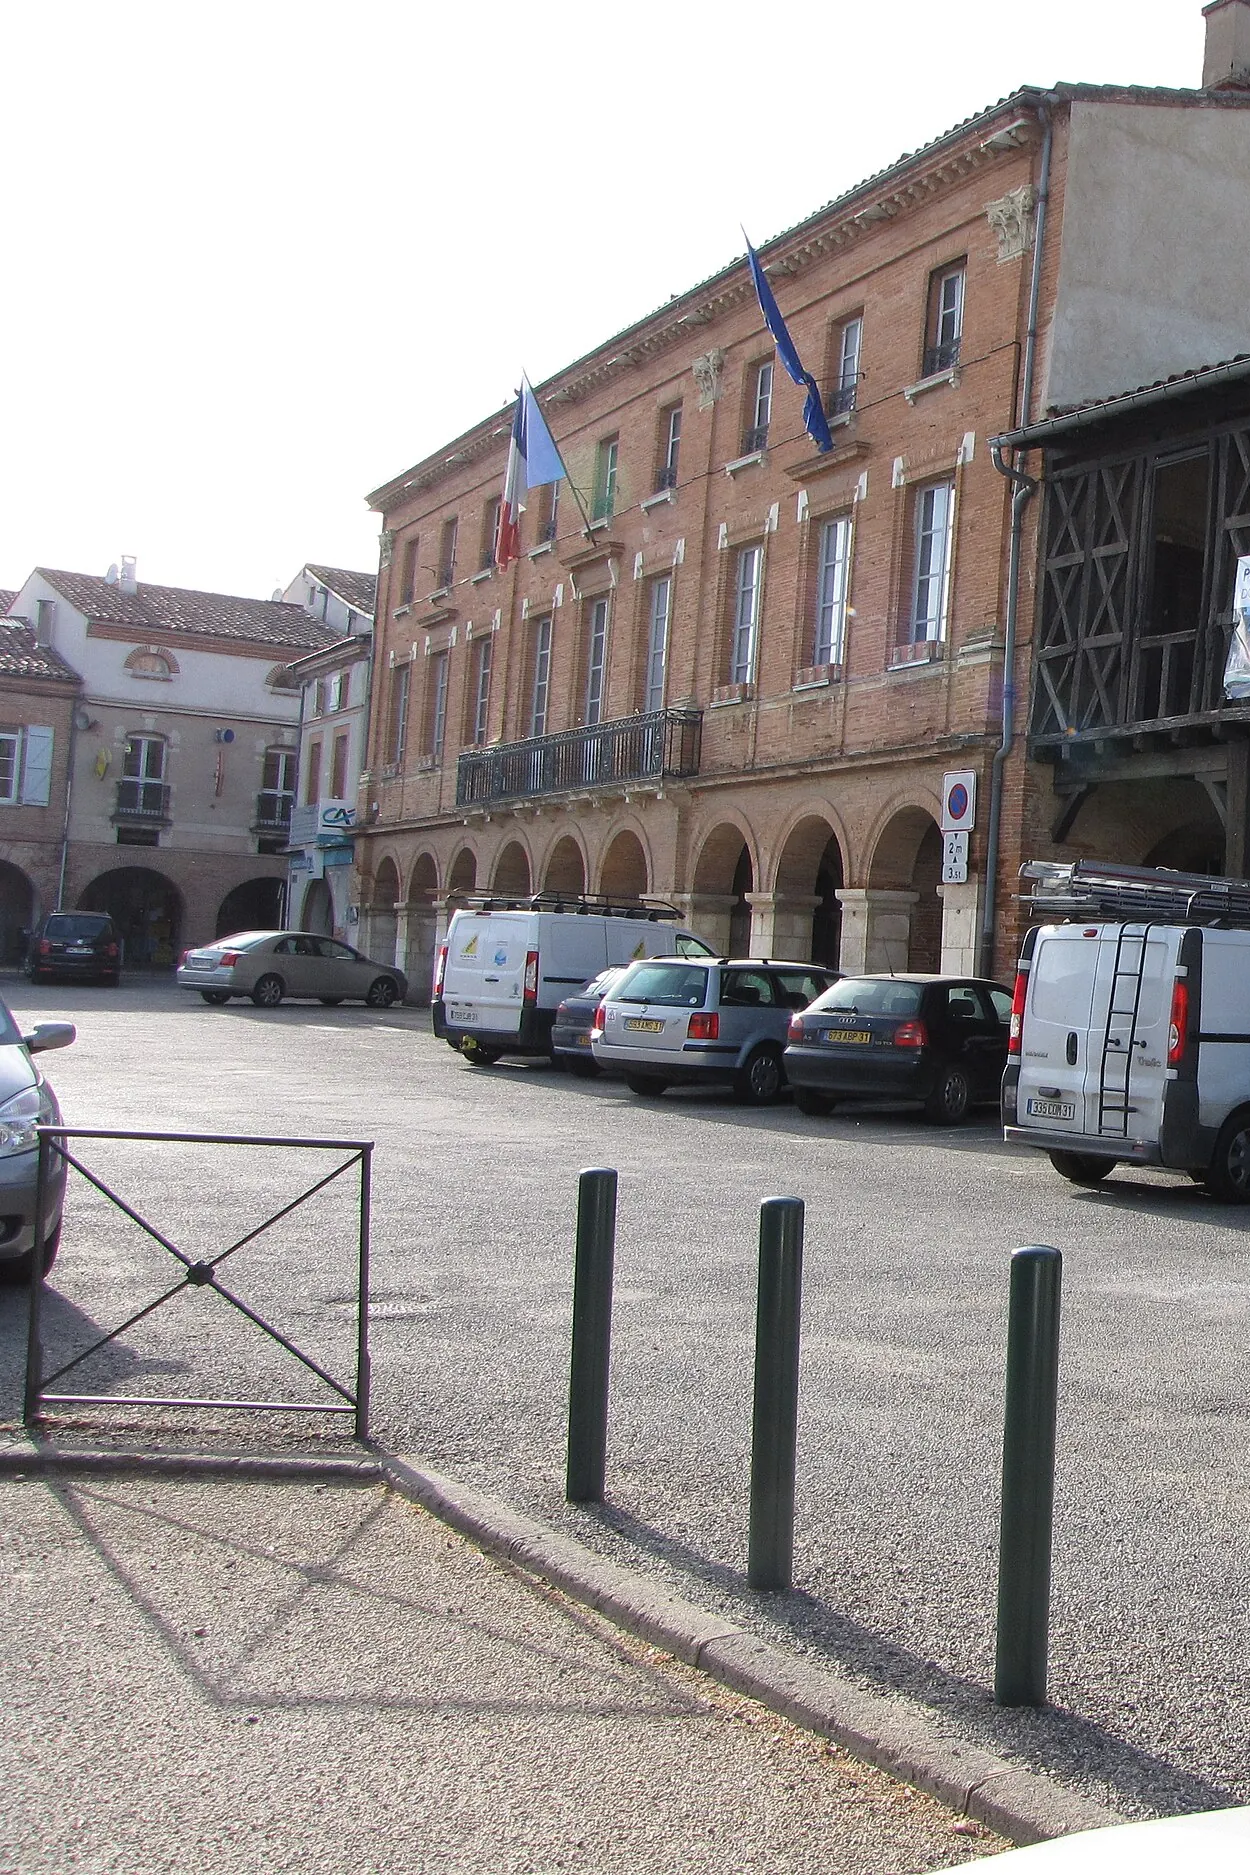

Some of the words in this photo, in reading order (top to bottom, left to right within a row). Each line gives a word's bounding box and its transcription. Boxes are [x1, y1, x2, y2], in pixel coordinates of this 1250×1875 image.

[949, 843, 954, 854] 2
[955, 845, 963, 853] m
[828, 1030, 842, 1040] 673
[843, 1031, 857, 1041] ABP
[859, 1032, 869, 1042] 31
[1062, 1105, 1072, 1117] 31
